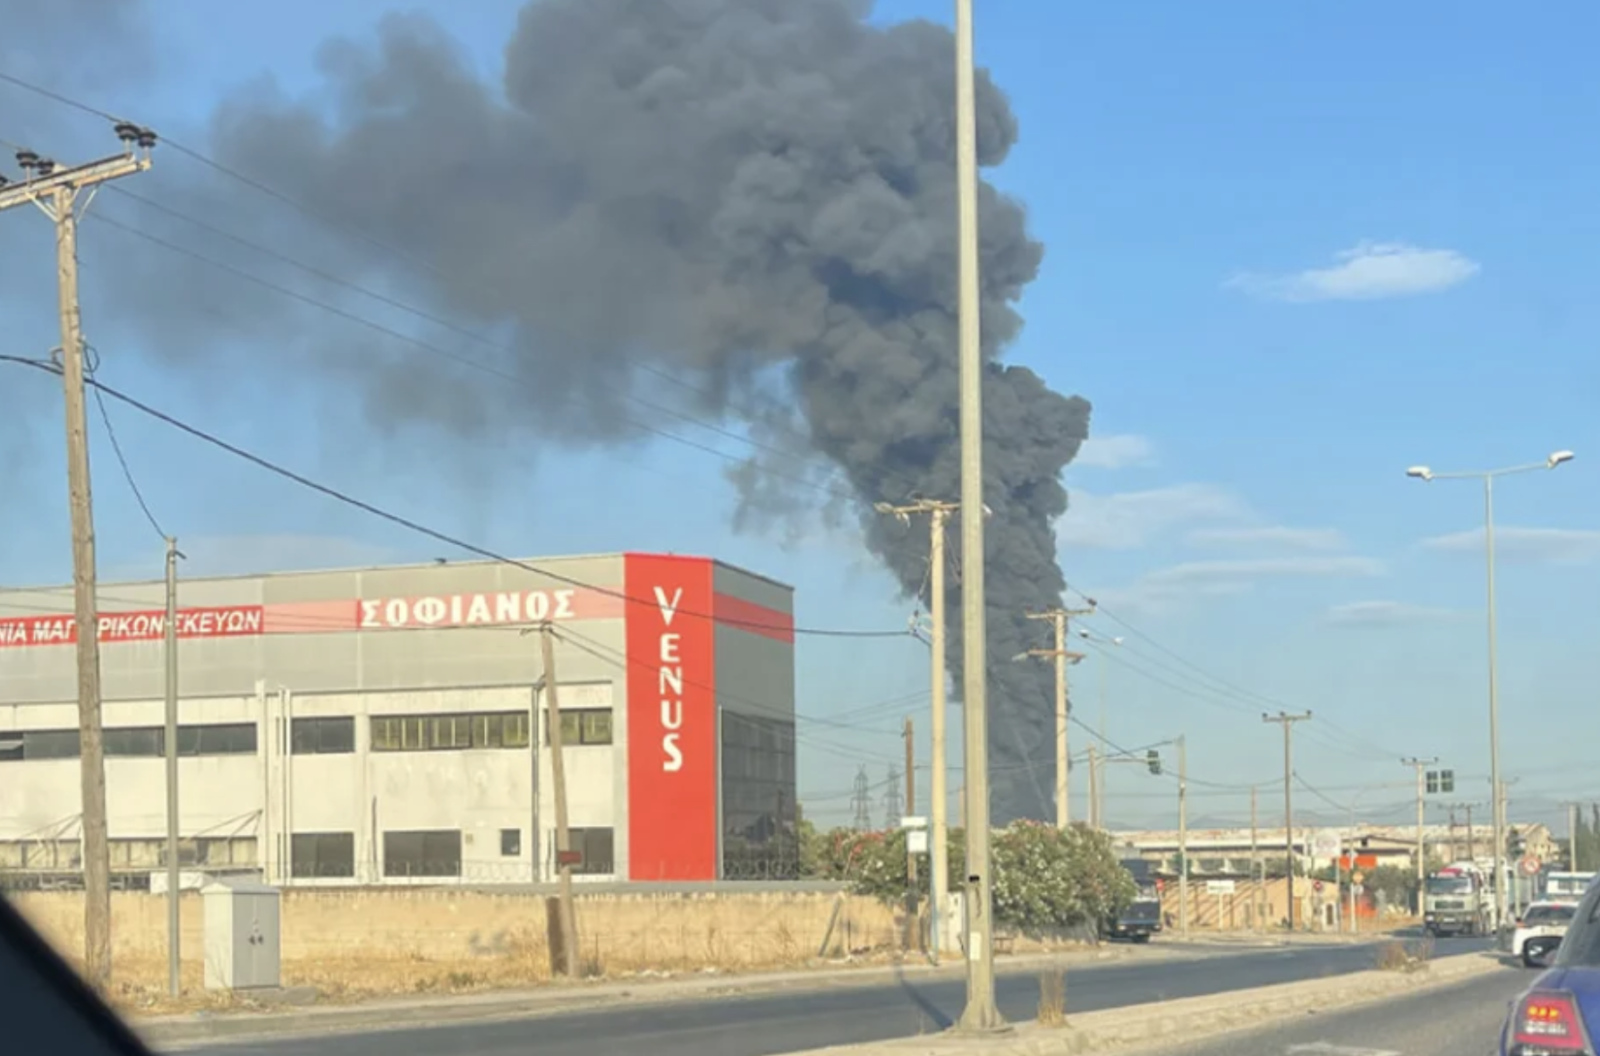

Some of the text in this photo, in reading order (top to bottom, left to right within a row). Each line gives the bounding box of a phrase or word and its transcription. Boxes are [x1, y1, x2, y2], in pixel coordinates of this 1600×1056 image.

[361, 589, 575, 627] ΣΟΦΙΑΝΟΣ
[33, 615, 164, 641] ΜΑΓΡΙΚΩΝ
[654, 586, 683, 771] VENUS
